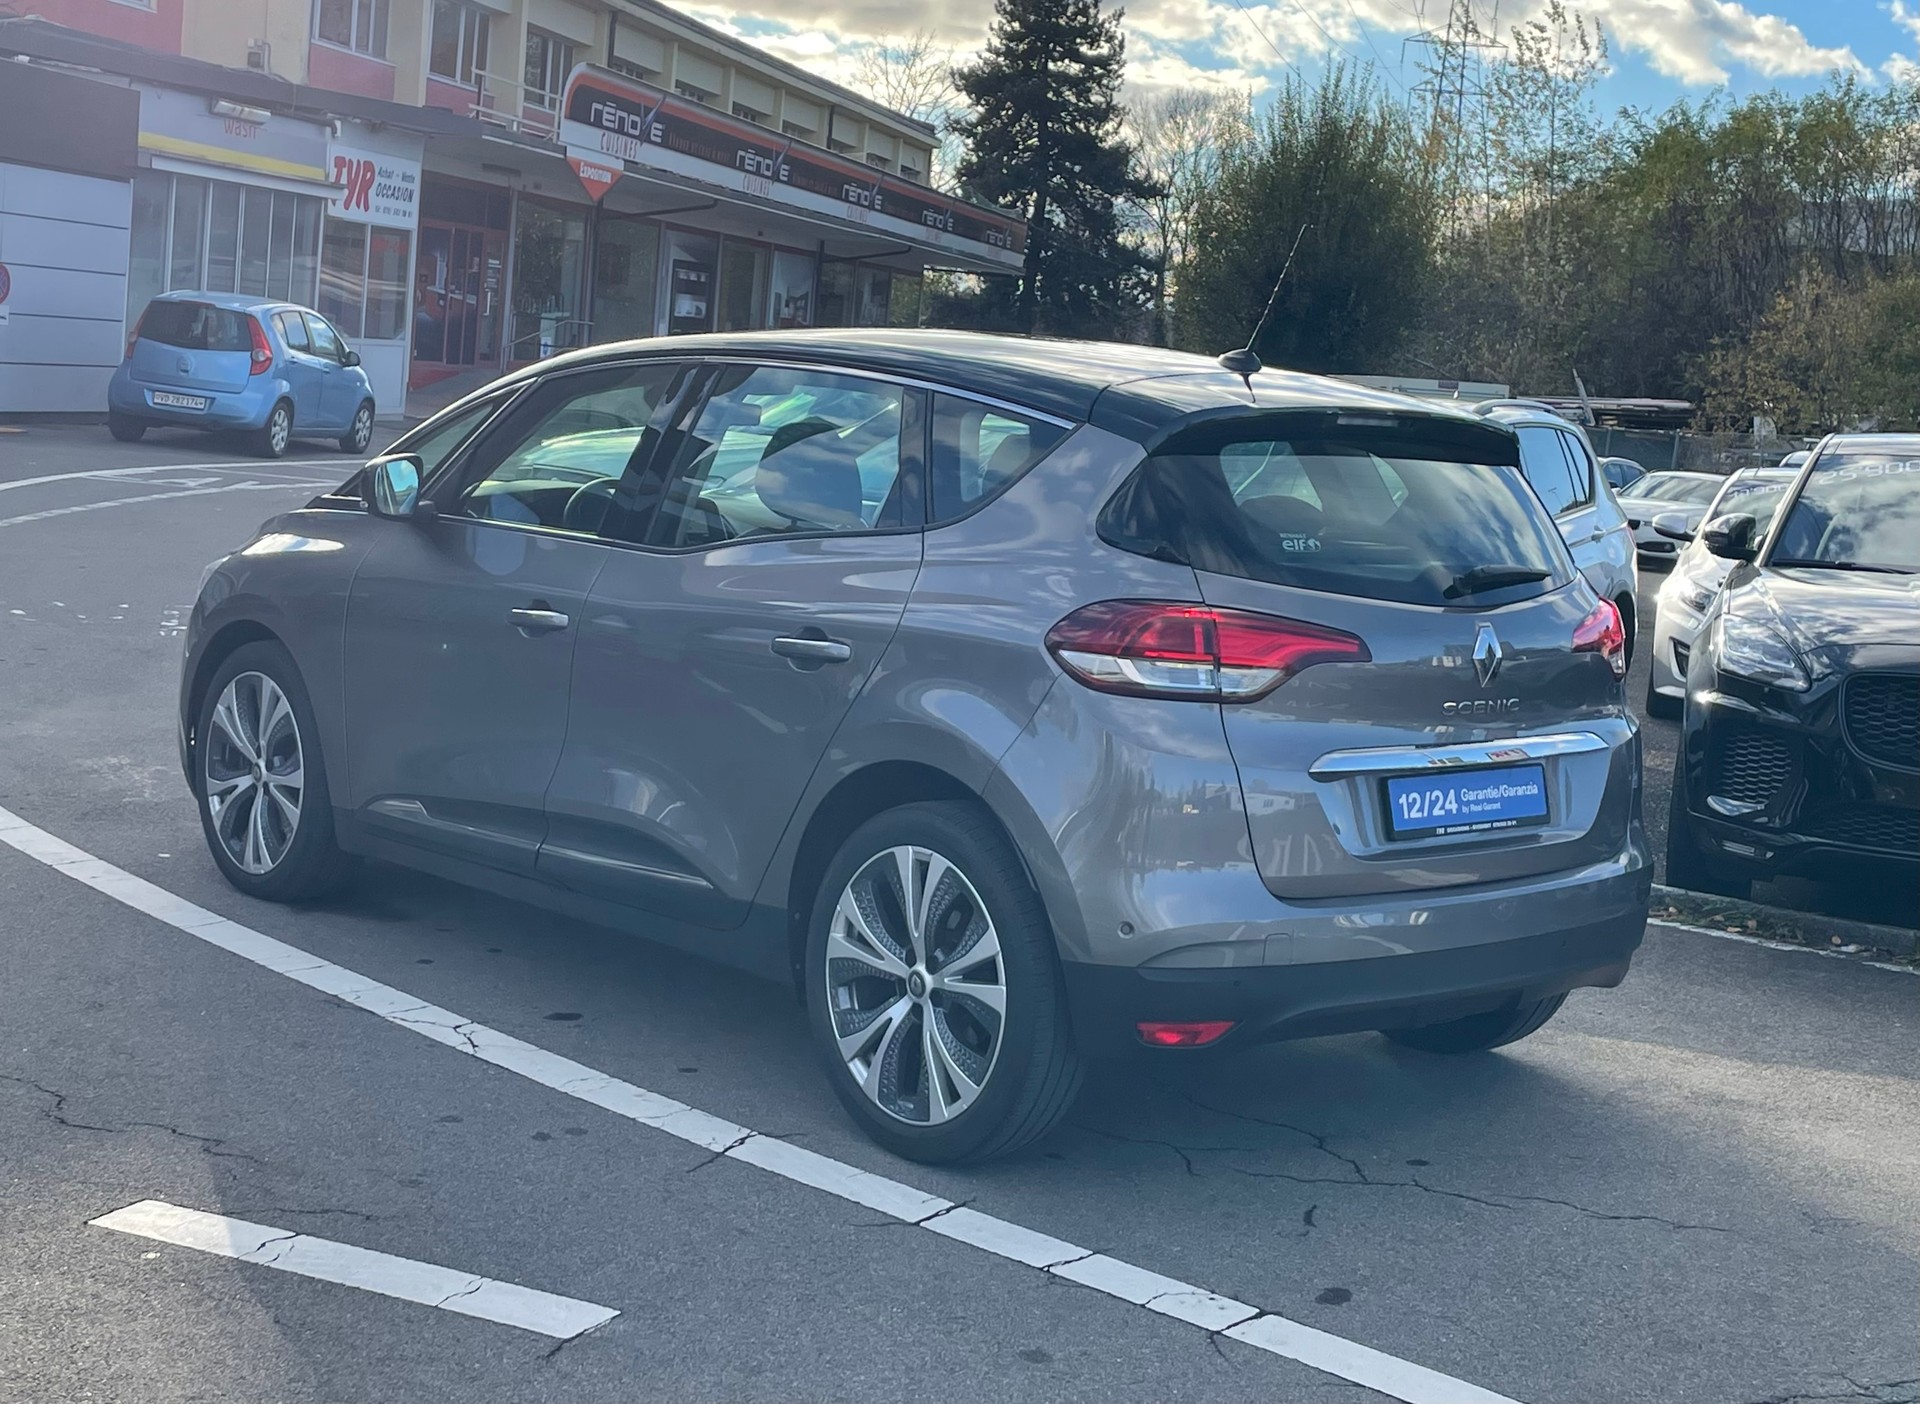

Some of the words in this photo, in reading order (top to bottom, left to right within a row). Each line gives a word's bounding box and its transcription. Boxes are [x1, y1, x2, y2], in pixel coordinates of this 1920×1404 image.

[600, 131, 638, 160] CUISINES
[333, 155, 376, 213] TYR
[375, 182, 415, 203] OCCASION
[1441, 697, 1520, 716] SCENIC
[1398, 788, 1459, 820] 12/24
[1460, 781, 1539, 802] Garantie/Garanzia
